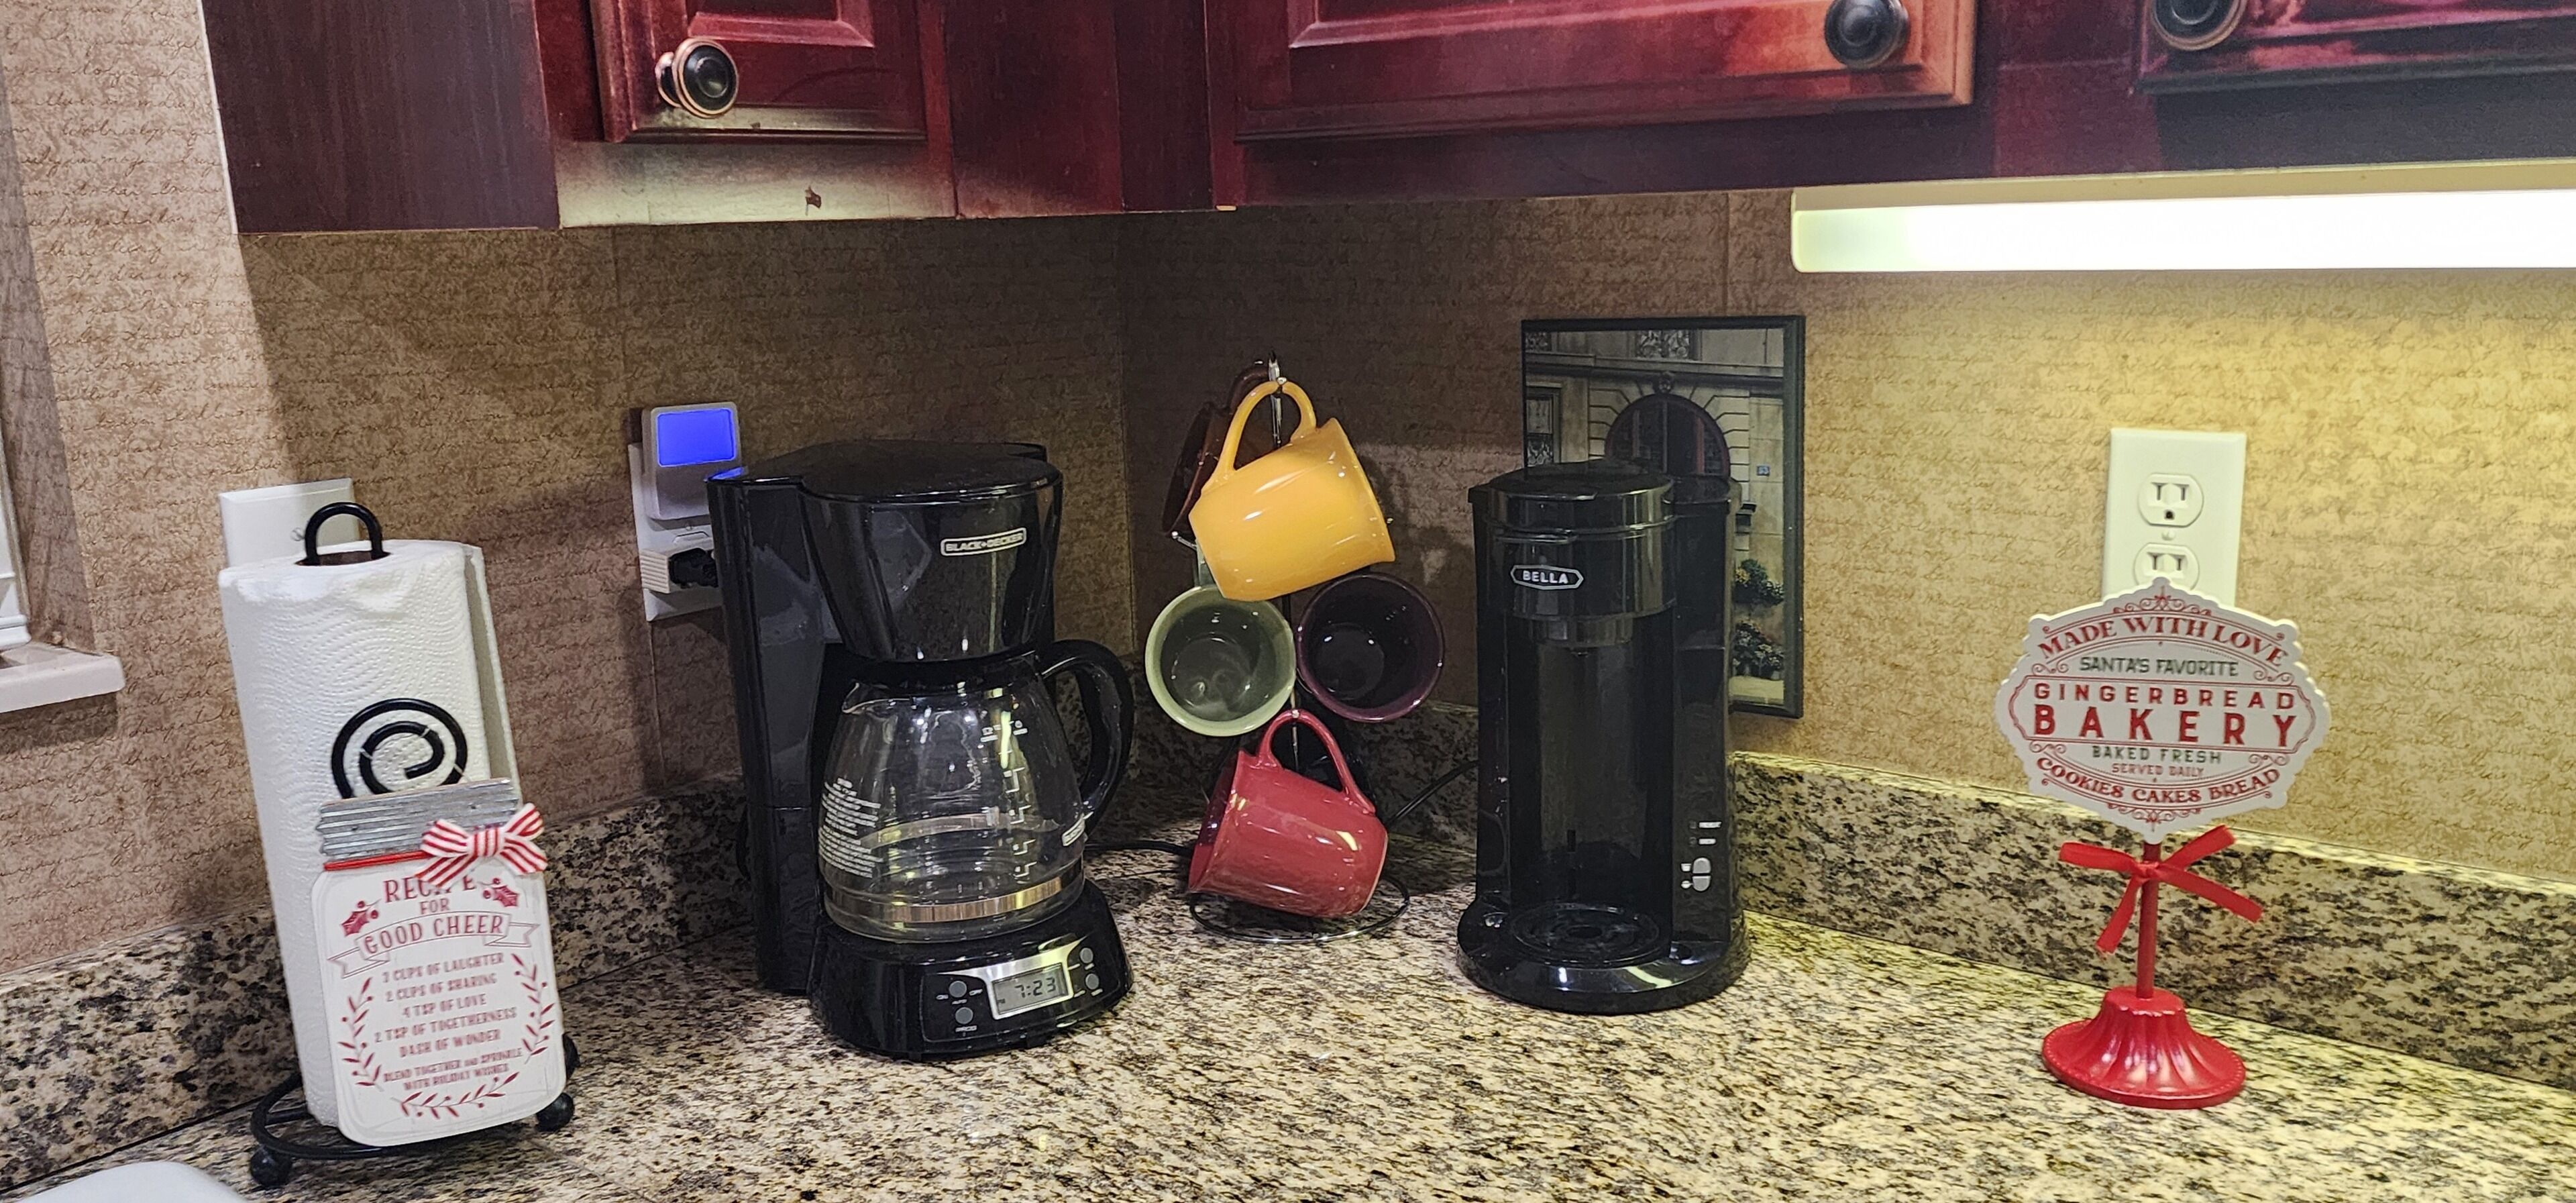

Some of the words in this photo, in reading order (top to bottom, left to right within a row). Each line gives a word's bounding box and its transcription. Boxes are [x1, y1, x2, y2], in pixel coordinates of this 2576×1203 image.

[1522, 570, 1568, 584] BELLA
[2037, 621, 2117, 658] MADE
[2121, 617, 2206, 637] WITH
[2212, 625, 2288, 667] LOVE
[2080, 656, 2149, 673] SANTA'S
[2155, 659, 2239, 677] FAVORITE
[2034, 682, 2295, 710] GINGERBREAD
[2033, 704, 2296, 747] BAKERY
[2092, 745, 2150, 761] BAKED
[2160, 747, 2222, 764] FRESH
[2036, 757, 2123, 798] COOKIES
[2132, 788, 2202, 803] CAKES
[2208, 769, 2281, 800] BREAD
[2112, 764, 2163, 776] SERVED
[2169, 765, 2204, 777] DAILY
[383, 874, 477, 903] RECE
[419, 898, 449, 914] FOR
[365, 922, 423, 954] GOOD
[433, 915, 503, 937] CHEER
[393, 965, 423, 981] CUPS
[426, 963, 441, 975] OF
[443, 952, 504, 973] LAUGHTER
[396, 985, 426, 1000] CUPS
[429, 982, 443, 994] OF
[447, 973, 497, 991] SHARING
[1015, 976, 1057, 998] 7:23
[402, 1006, 410, 1018] 4
[440, 999, 453, 1012] OF
[456, 993, 486, 1009] LOVE
[411, 1023, 426, 1036] OF
[429, 1007, 517, 1033] TOGETHERNESS
[399, 1041, 431, 1057] DASH
[435, 1038, 449, 1051] OF
[452, 1029, 501, 1047] WONDER
[384, 1069, 412, 1082] BLEND
[414, 1059, 461, 1076] TOGETHER
[480, 1047, 523, 1063] SPRINKLE
[404, 1078, 430, 1090] WITH
[433, 1070, 470, 1085] HOLIDAY
